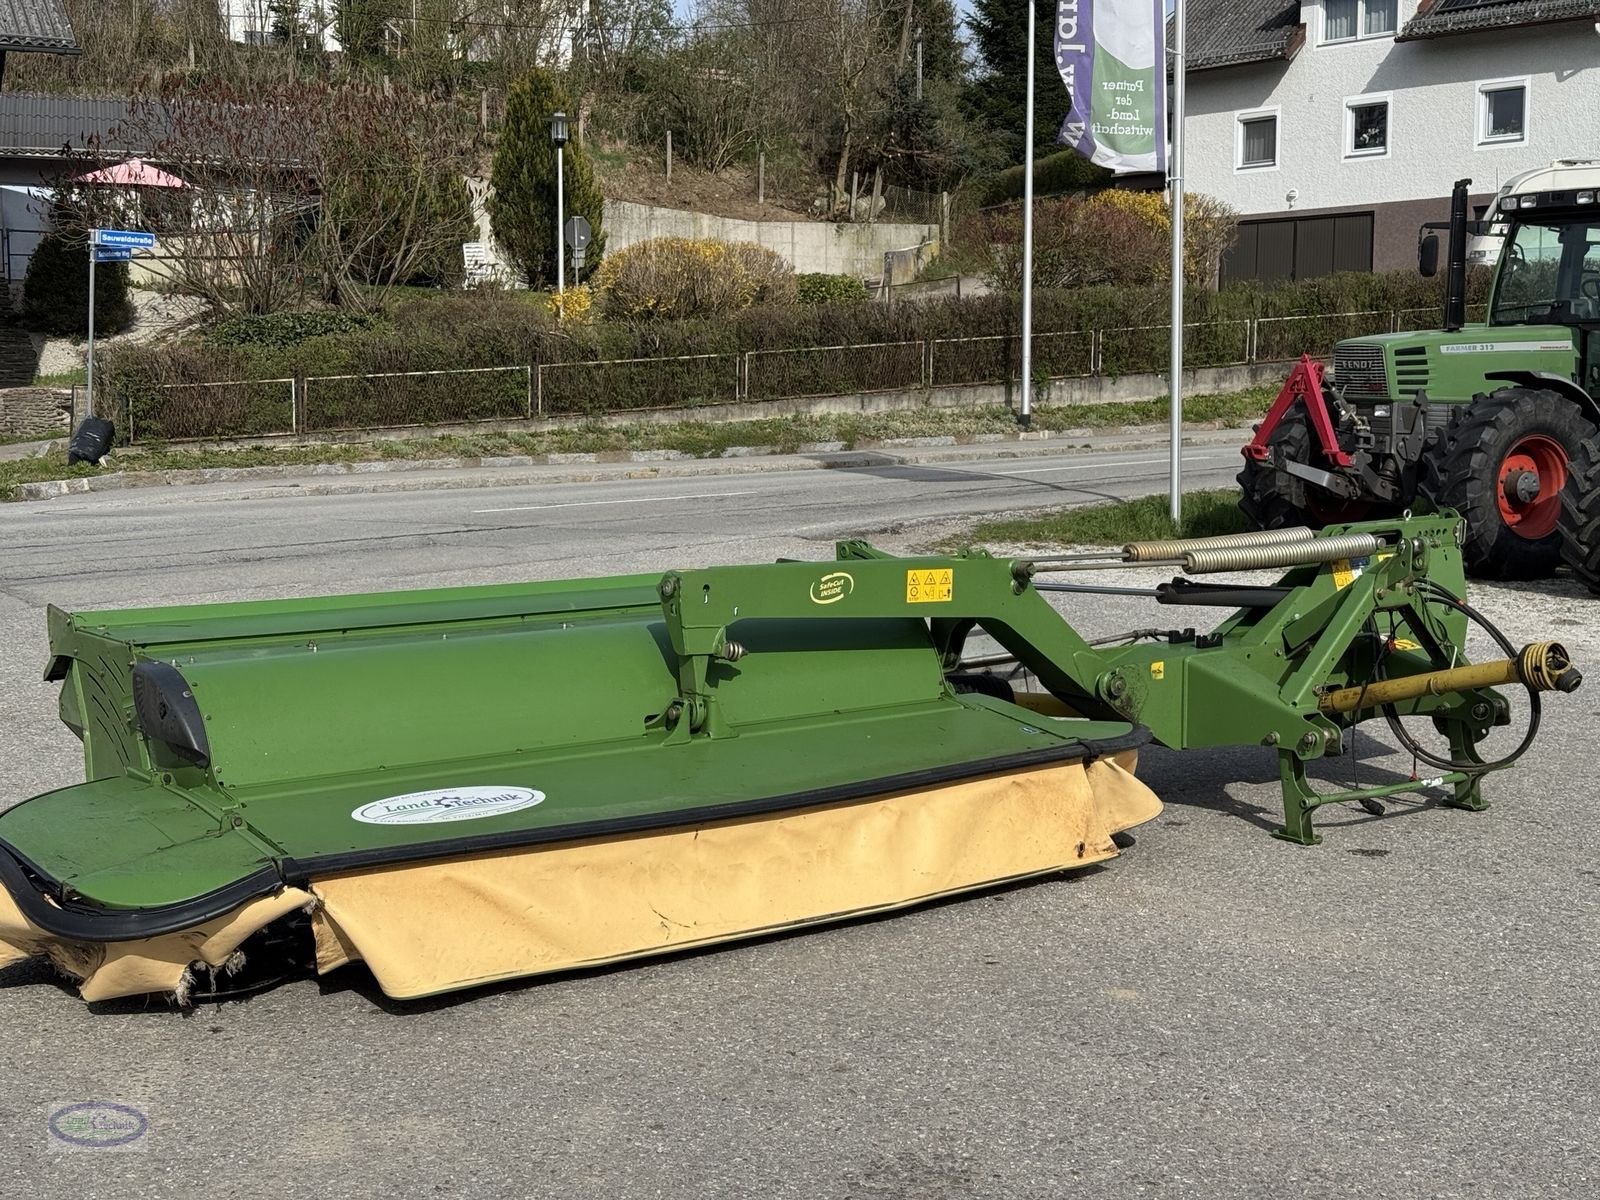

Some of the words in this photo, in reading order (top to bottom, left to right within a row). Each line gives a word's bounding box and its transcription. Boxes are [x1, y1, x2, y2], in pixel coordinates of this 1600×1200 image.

[102, 233, 152, 244] Sauwaldstraße
[1446, 344, 1477, 352] FARMER
[1342, 360, 1373, 369] FENDT
[820, 579, 844, 590] SafeCut
[820, 587, 841, 597] INSIDE
[384, 800, 432, 812] Land
[450, 794, 523, 807] Technik
